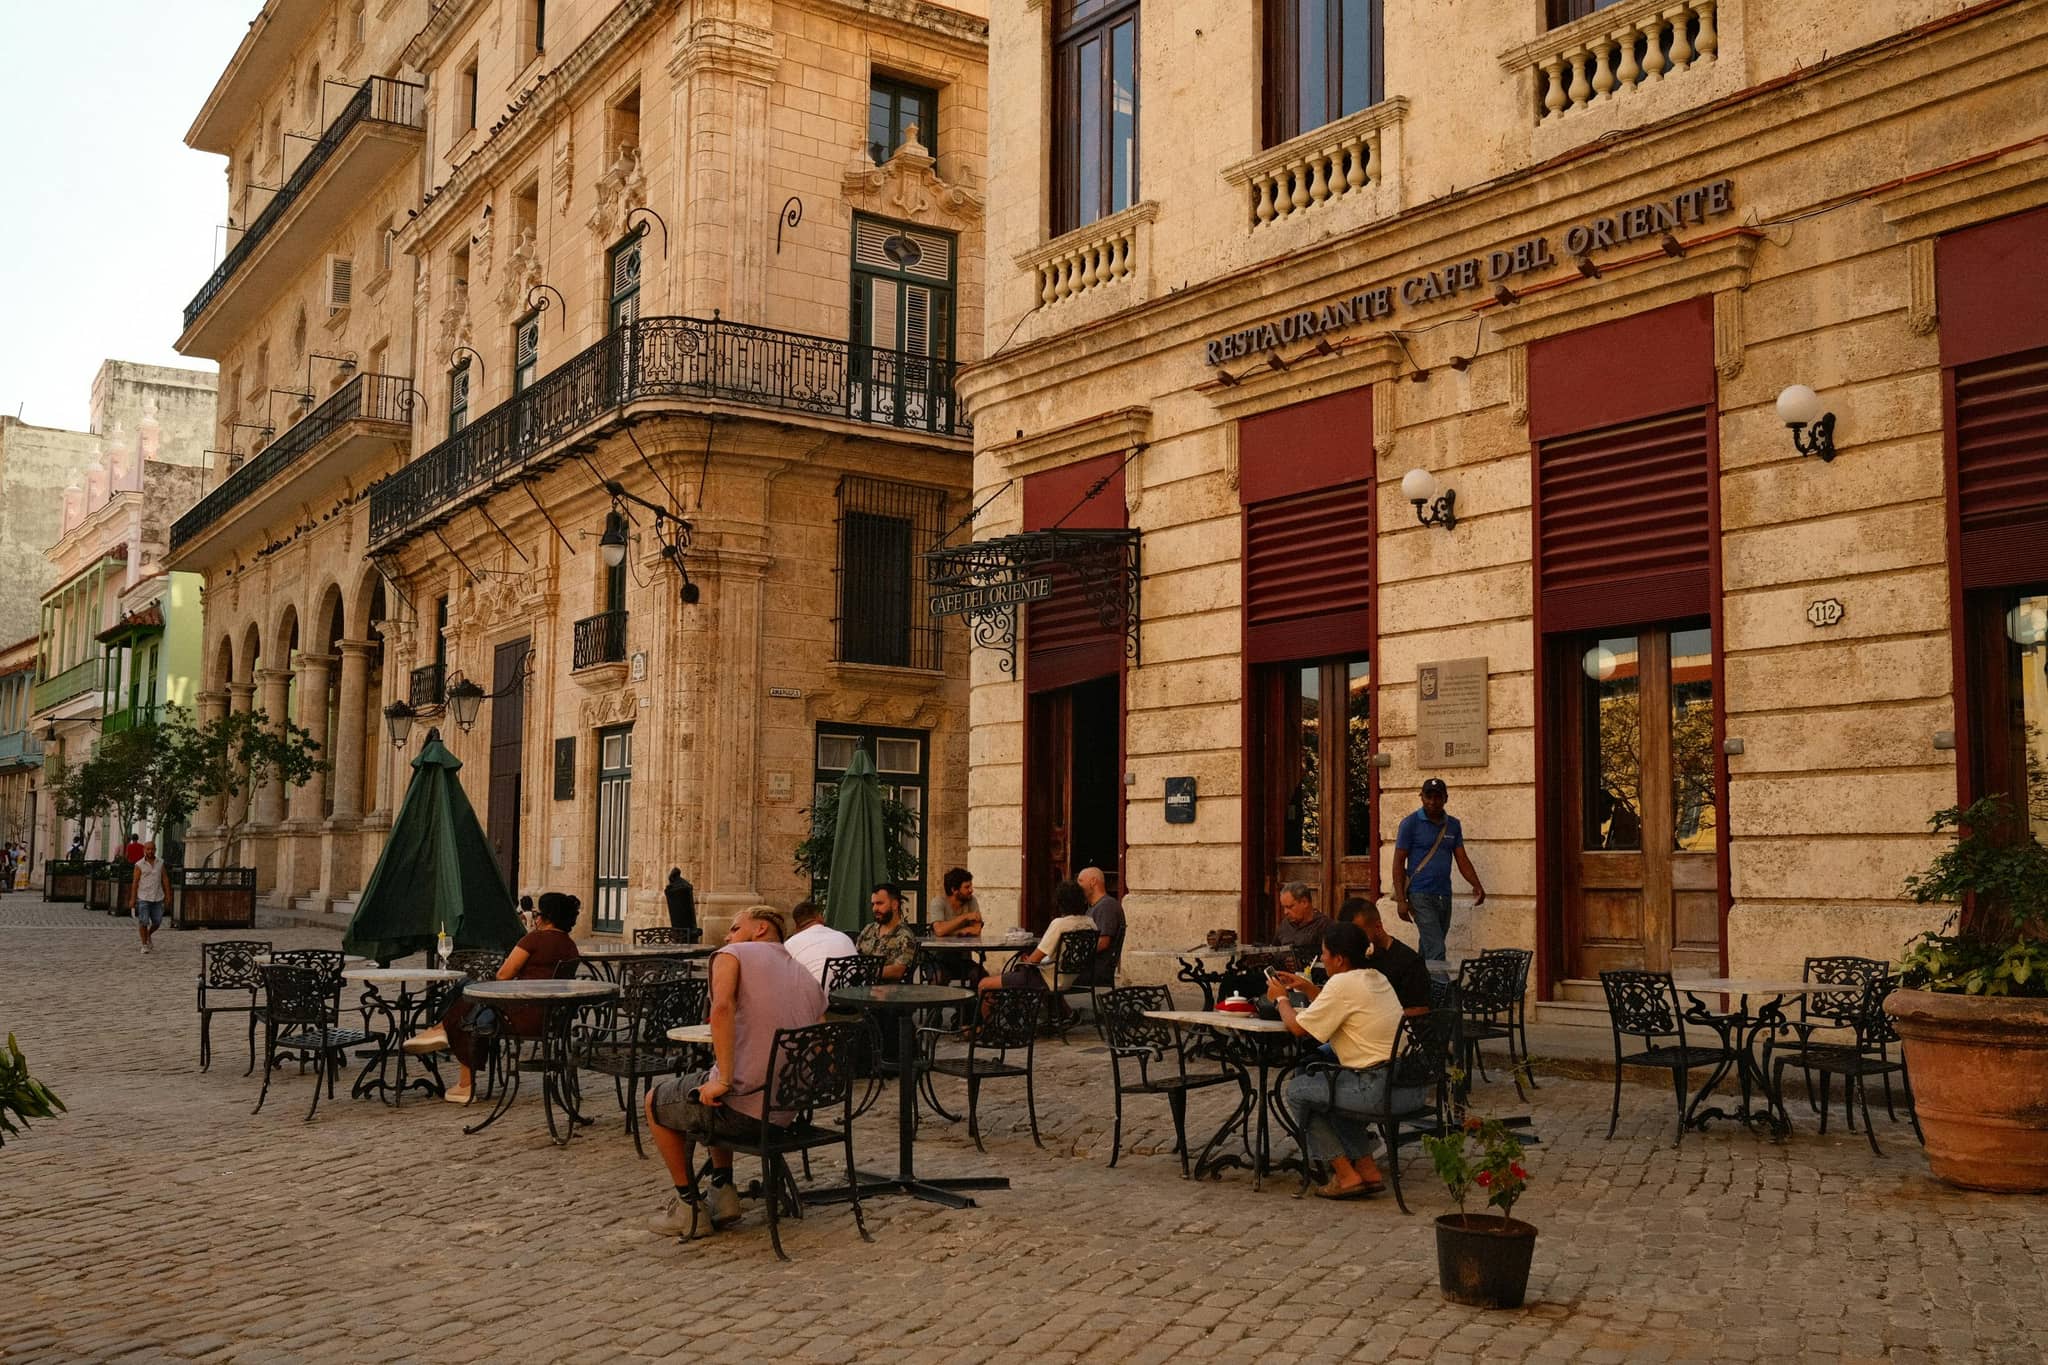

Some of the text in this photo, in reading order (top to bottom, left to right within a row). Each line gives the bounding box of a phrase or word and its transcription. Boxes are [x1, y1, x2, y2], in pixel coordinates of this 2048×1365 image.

[1204, 178, 1732, 366] RESTAURANTE CAFE DEL ORIENTE
[930, 578, 1049, 615] CAFE DEL ORIENTE
[1815, 604, 1836, 622] 112
